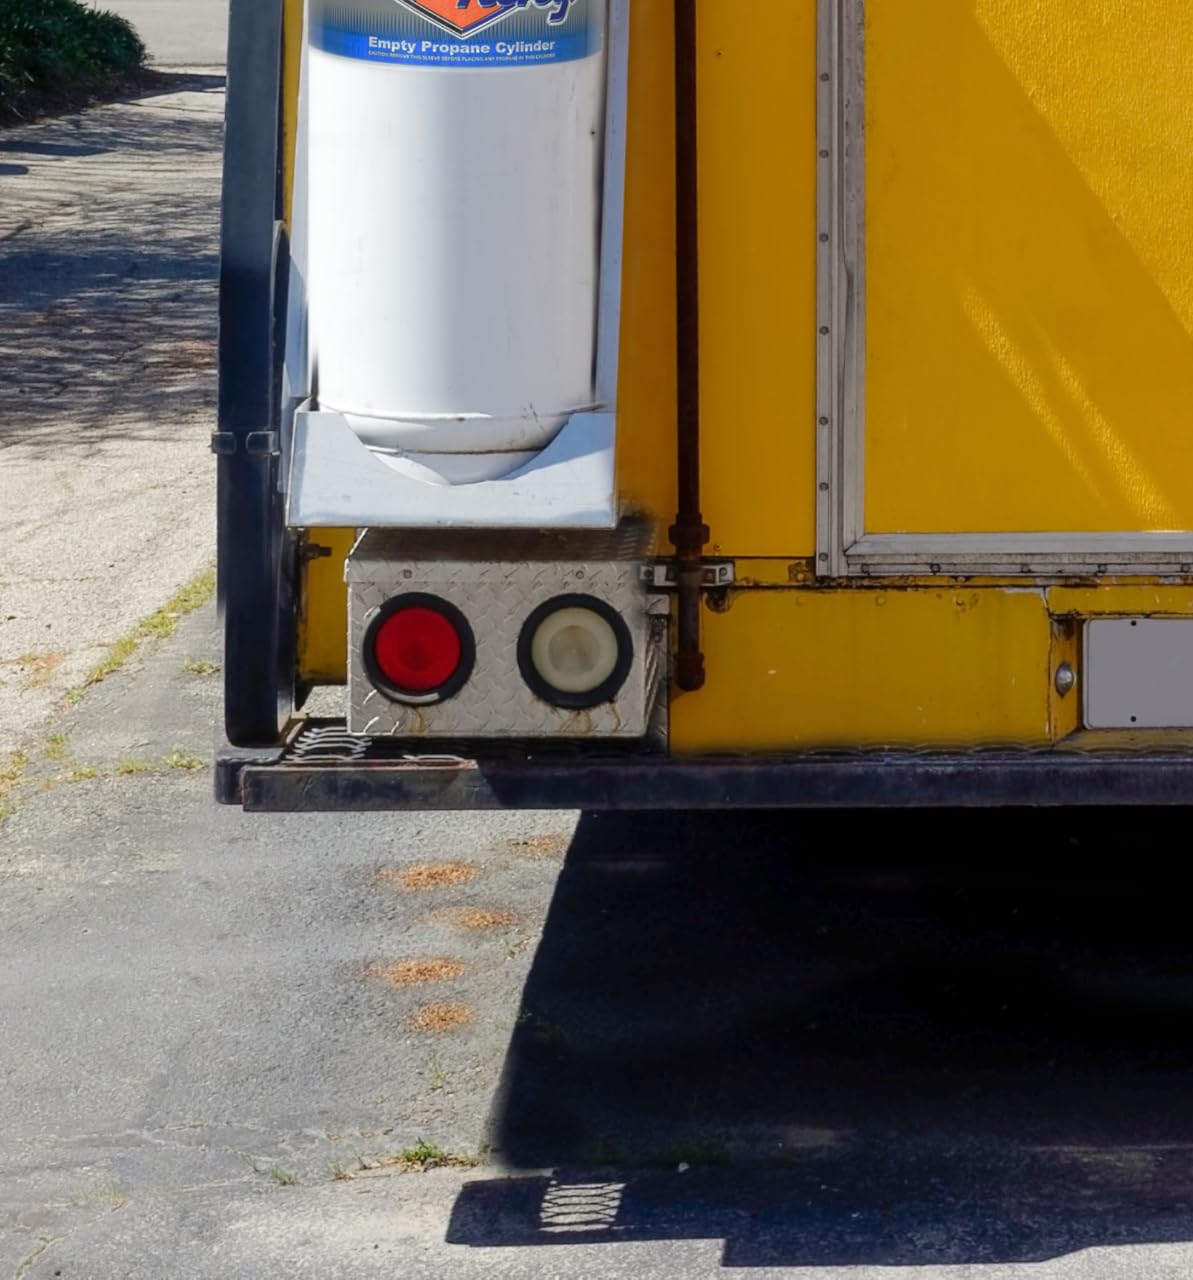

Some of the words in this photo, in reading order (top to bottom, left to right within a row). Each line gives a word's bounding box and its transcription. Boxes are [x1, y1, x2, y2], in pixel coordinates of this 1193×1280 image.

[368, 36, 416, 54] Empty
[421, 40, 491, 56] Propane
[495, 40, 556, 56] Cylinder
